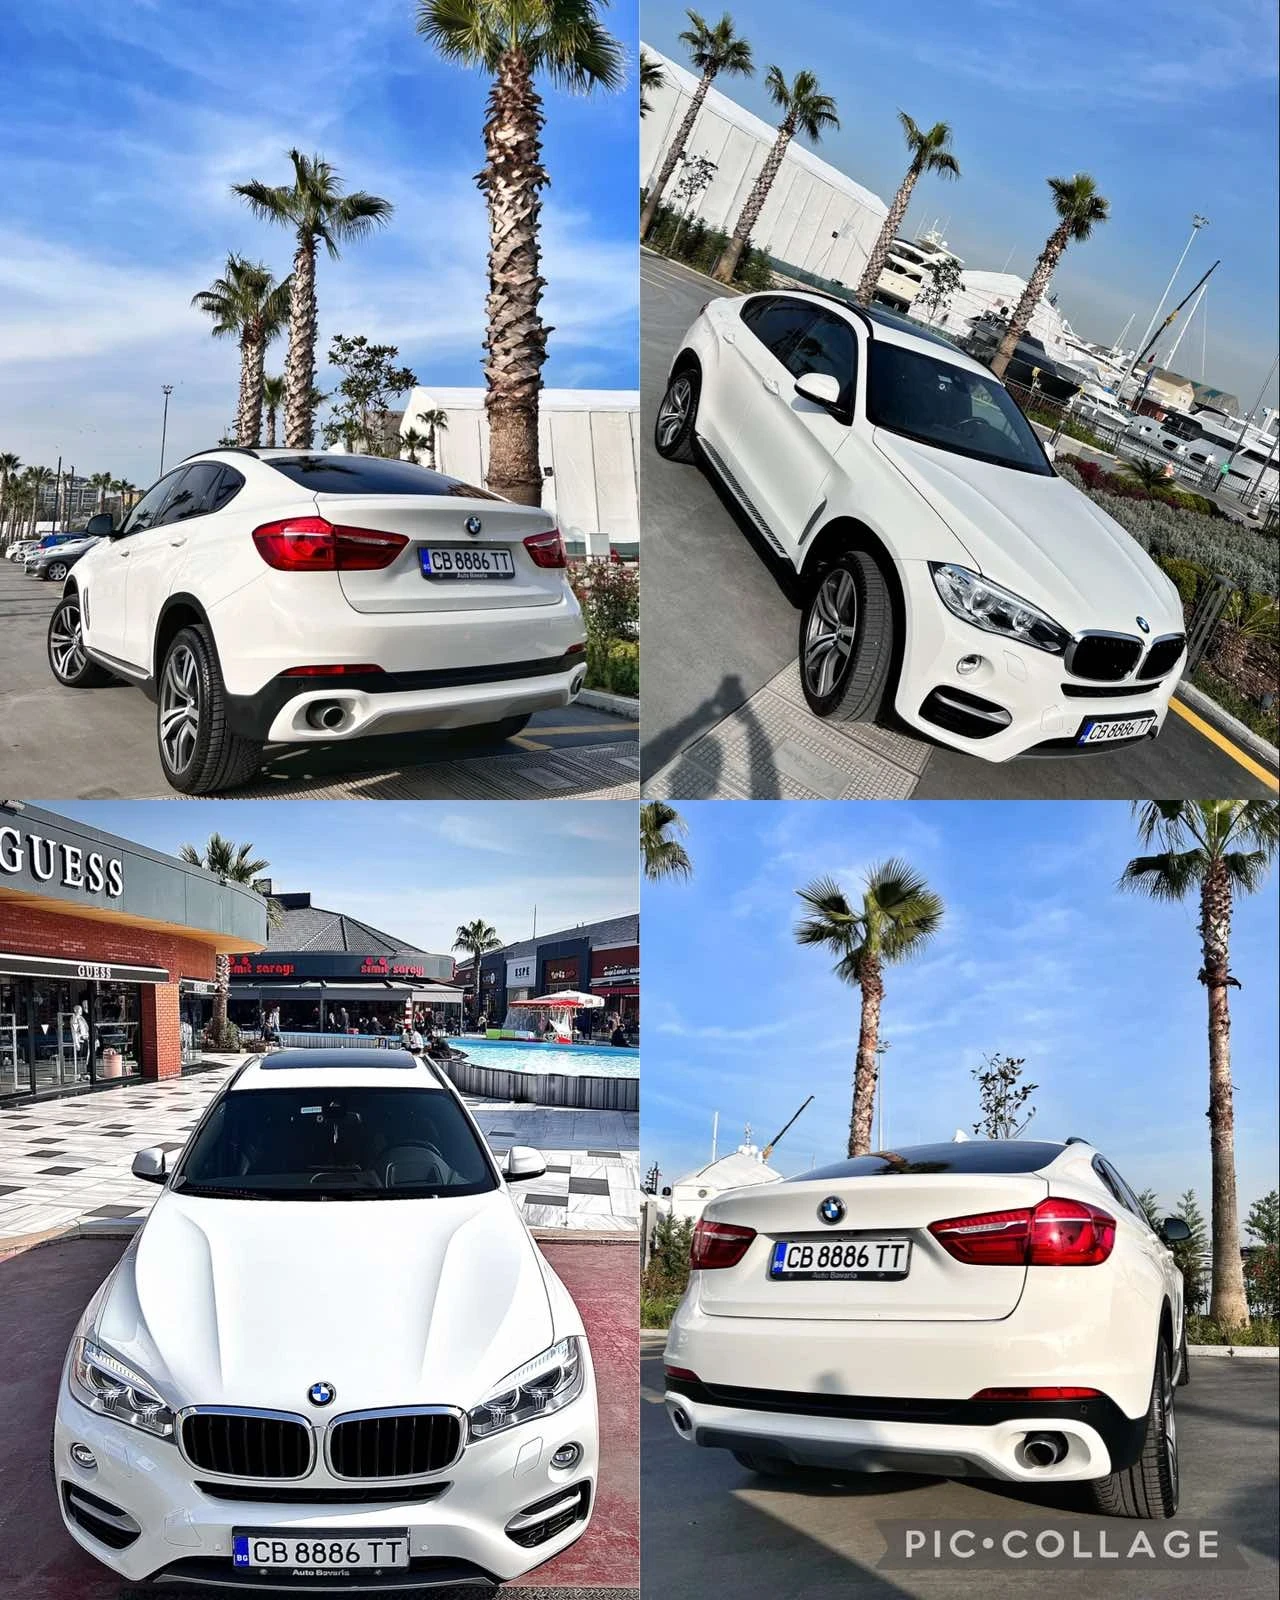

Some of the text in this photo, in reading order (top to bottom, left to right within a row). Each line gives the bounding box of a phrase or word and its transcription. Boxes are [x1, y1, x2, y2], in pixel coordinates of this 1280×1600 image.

[431, 552, 508, 570] CB 8886 TT
[1089, 719, 1154, 740] CB 8886 TT
[0, 826, 124, 897] GUESS
[77, 965, 112, 979] GUESS
[787, 1244, 905, 1268] CB 8886 TT
[830, 1271, 858, 1279] Bavaria
[253, 1541, 402, 1564] CB 8886 TT
